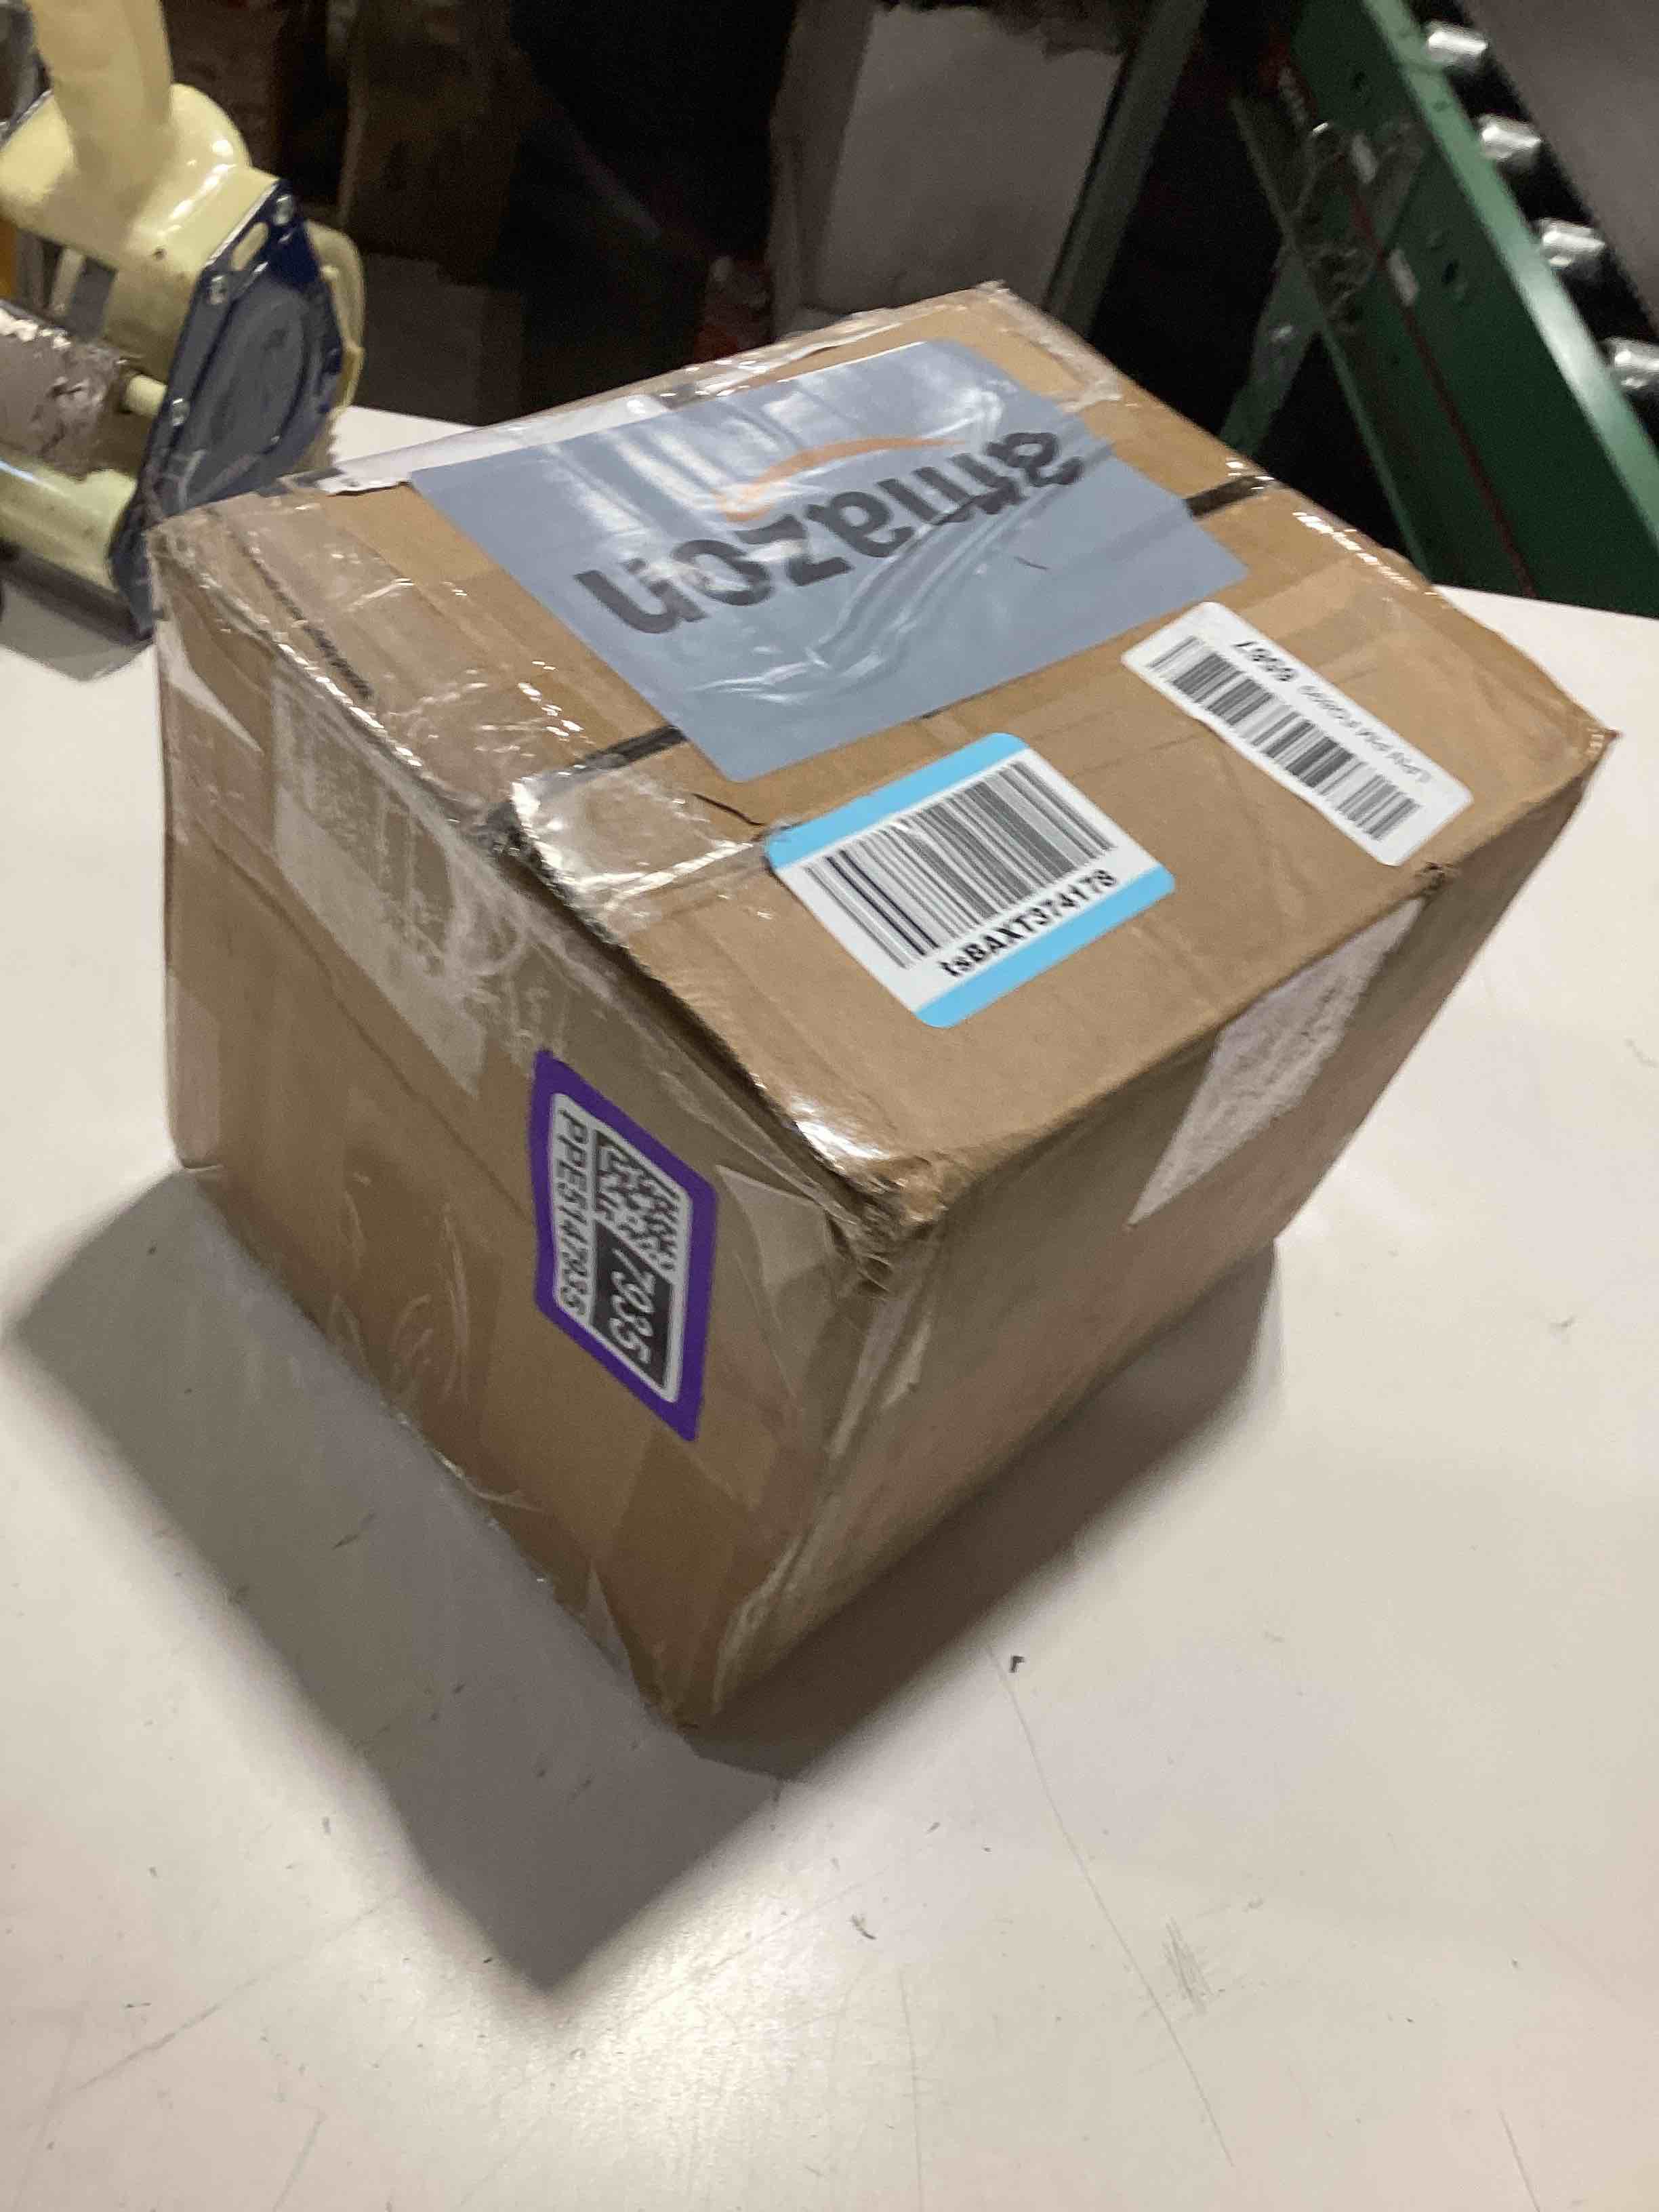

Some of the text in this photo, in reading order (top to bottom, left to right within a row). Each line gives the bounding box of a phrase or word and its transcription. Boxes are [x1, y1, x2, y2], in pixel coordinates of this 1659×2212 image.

[573, 430, 1086, 634] amazon
[938, 868, 1118, 978] tsBAXT374178
[609, 1247, 656, 1366] 7935
